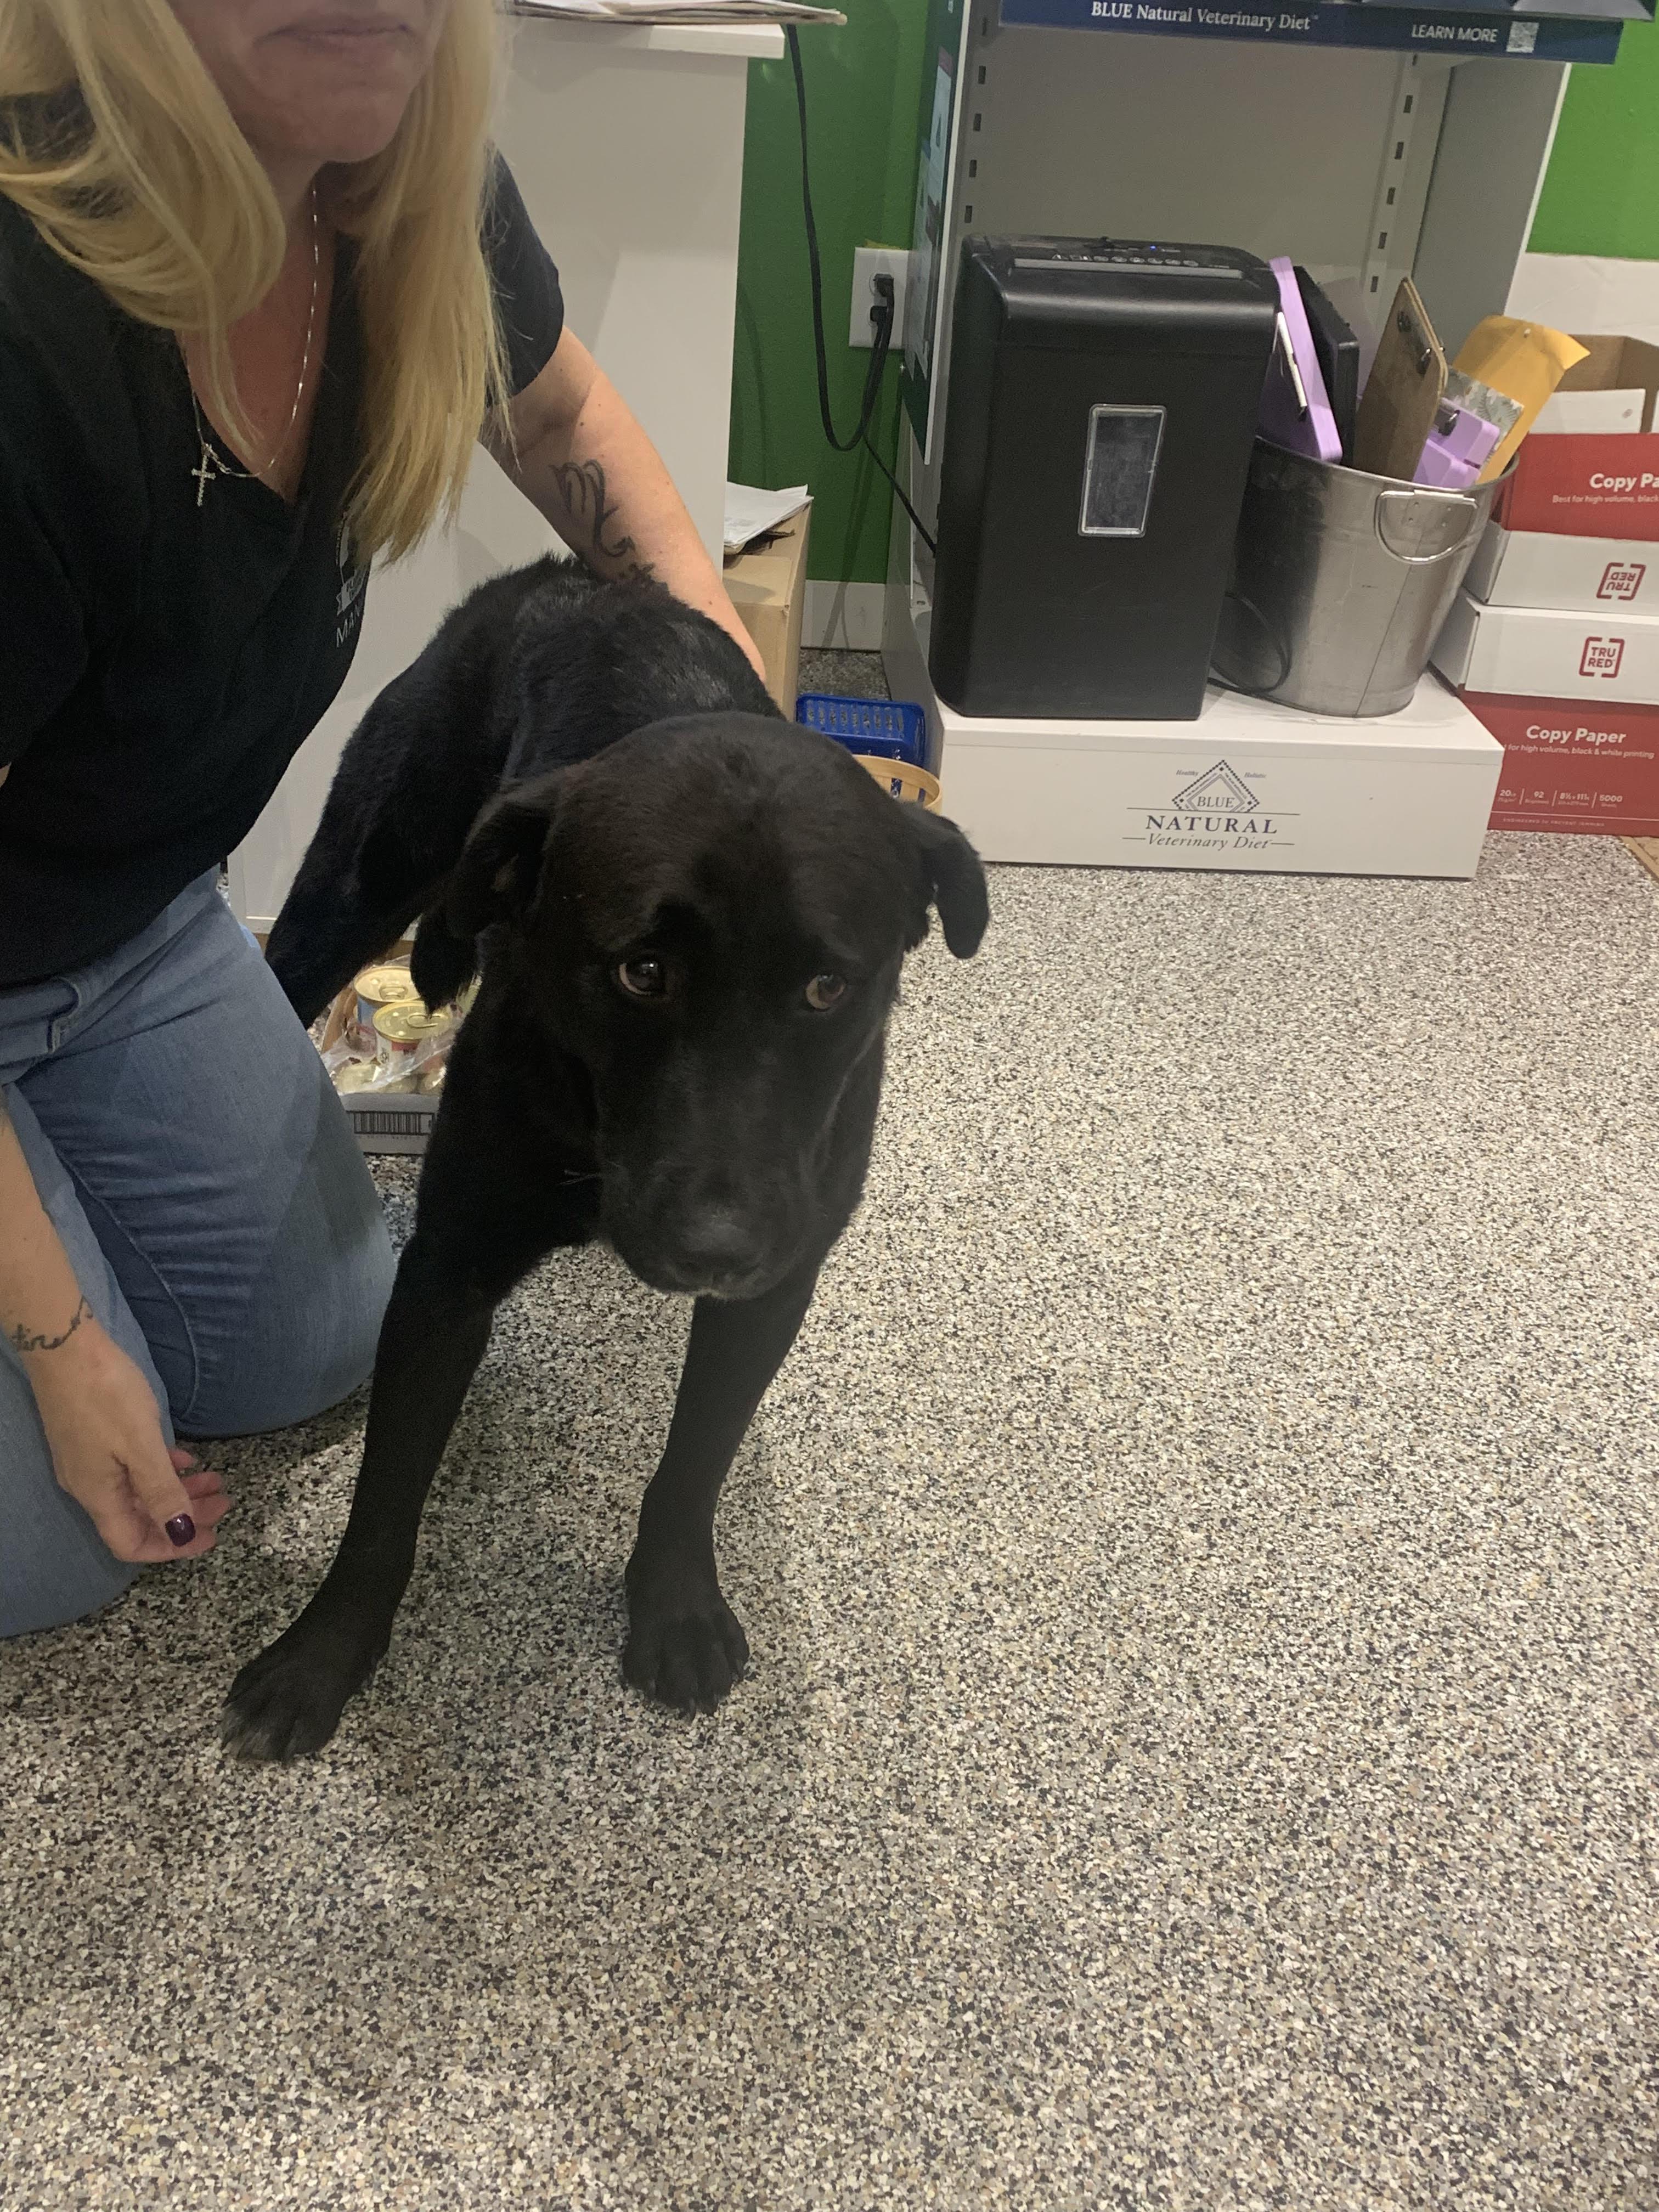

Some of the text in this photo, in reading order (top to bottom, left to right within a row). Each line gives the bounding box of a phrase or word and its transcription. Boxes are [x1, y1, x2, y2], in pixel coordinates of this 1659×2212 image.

[1091, 1, 1133, 18] BLUE
[1136, 4, 1193, 22] Natural
[1197, 8, 1276, 32] Veterinary
[1411, 24, 1498, 42] LEARN MORE
[1589, 473, 1638, 492] Copy
[1552, 495, 1570, 503] Best
[1610, 572, 1636, 582] RED
[1606, 582, 1630, 591] TRU
[1591, 647, 1616, 657] TRU
[1587, 657, 1613, 668] RED
[1526, 725, 1627, 746] Copy Paper
[1520, 744, 1538, 754] high
[1197, 796, 1235, 808] BLUE
[1534, 791, 1544, 799] 92
[1599, 794, 1623, 803] 5000
[1146, 815, 1278, 834] NATURAL
[1149, 833, 1271, 851] Veterinary Diet
